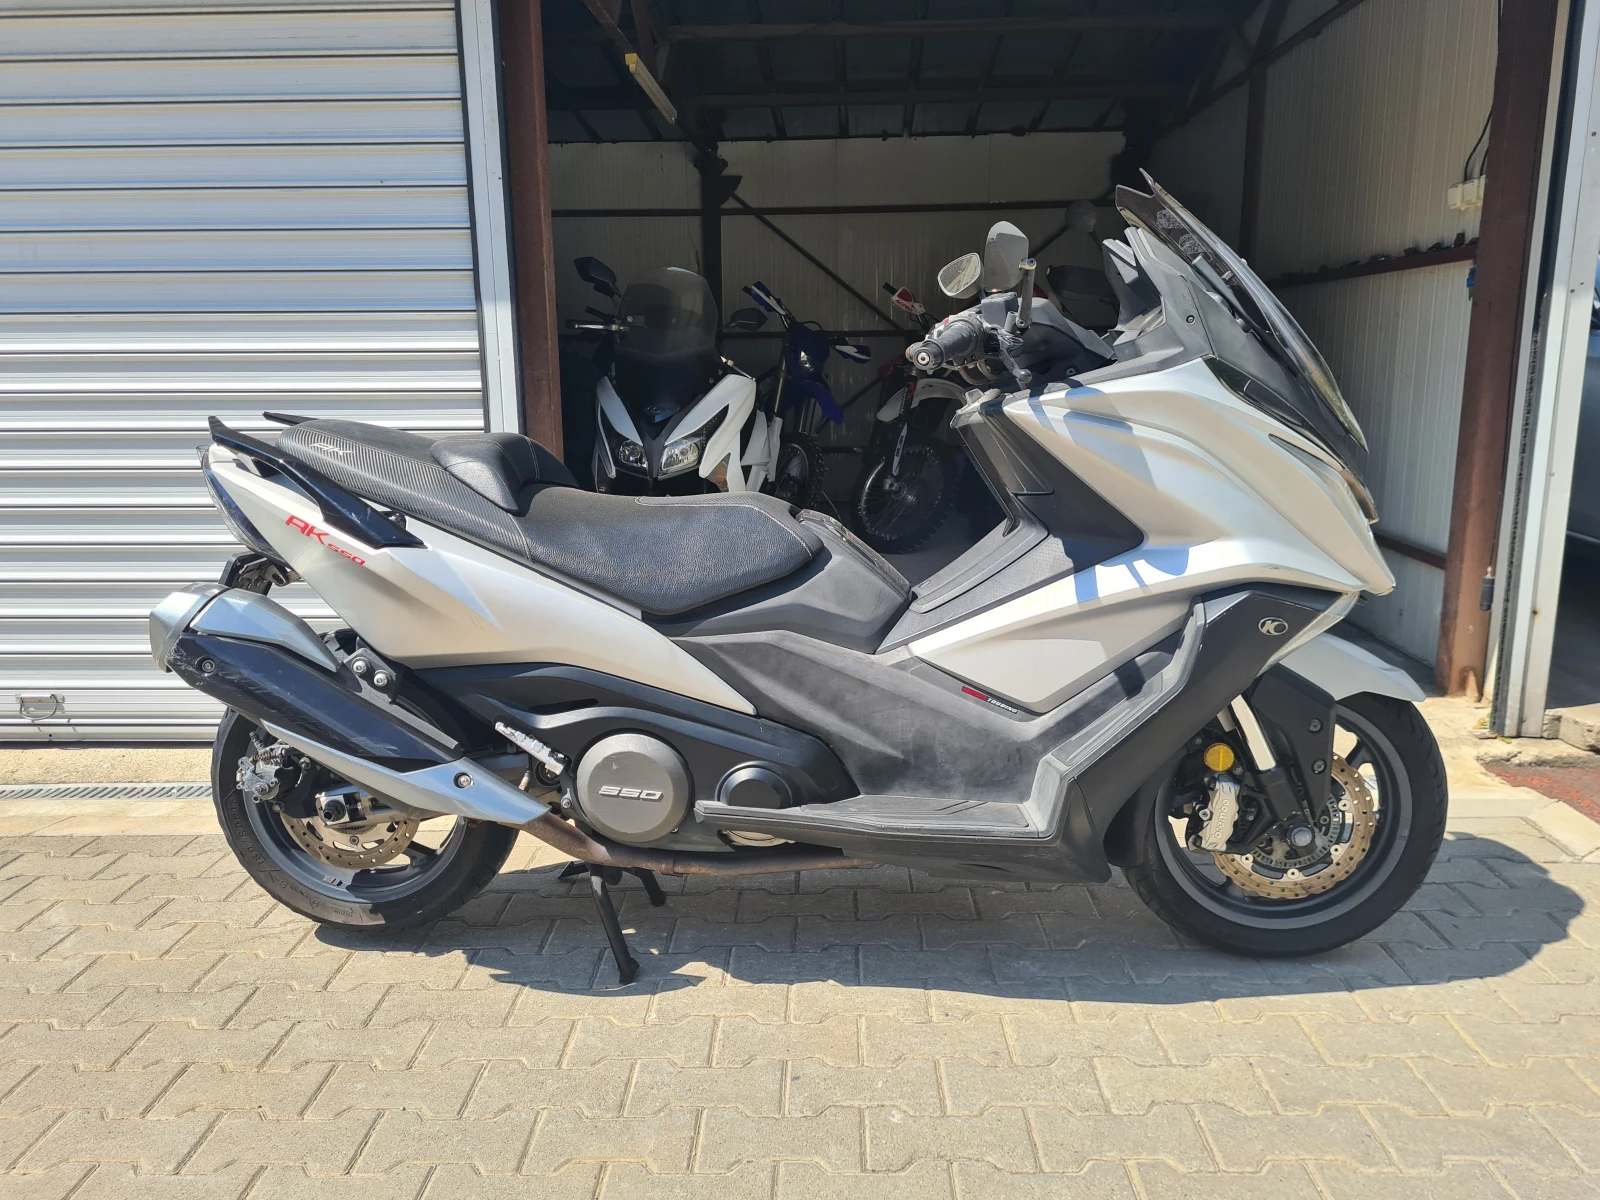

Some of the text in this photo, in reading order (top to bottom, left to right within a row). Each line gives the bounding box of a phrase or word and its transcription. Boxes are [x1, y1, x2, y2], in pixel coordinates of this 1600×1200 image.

[285, 515, 365, 566] AK 550
[987, 698, 1018, 714] TOURING
[598, 785, 664, 802] 550
[1211, 799, 1230, 839] brembo
